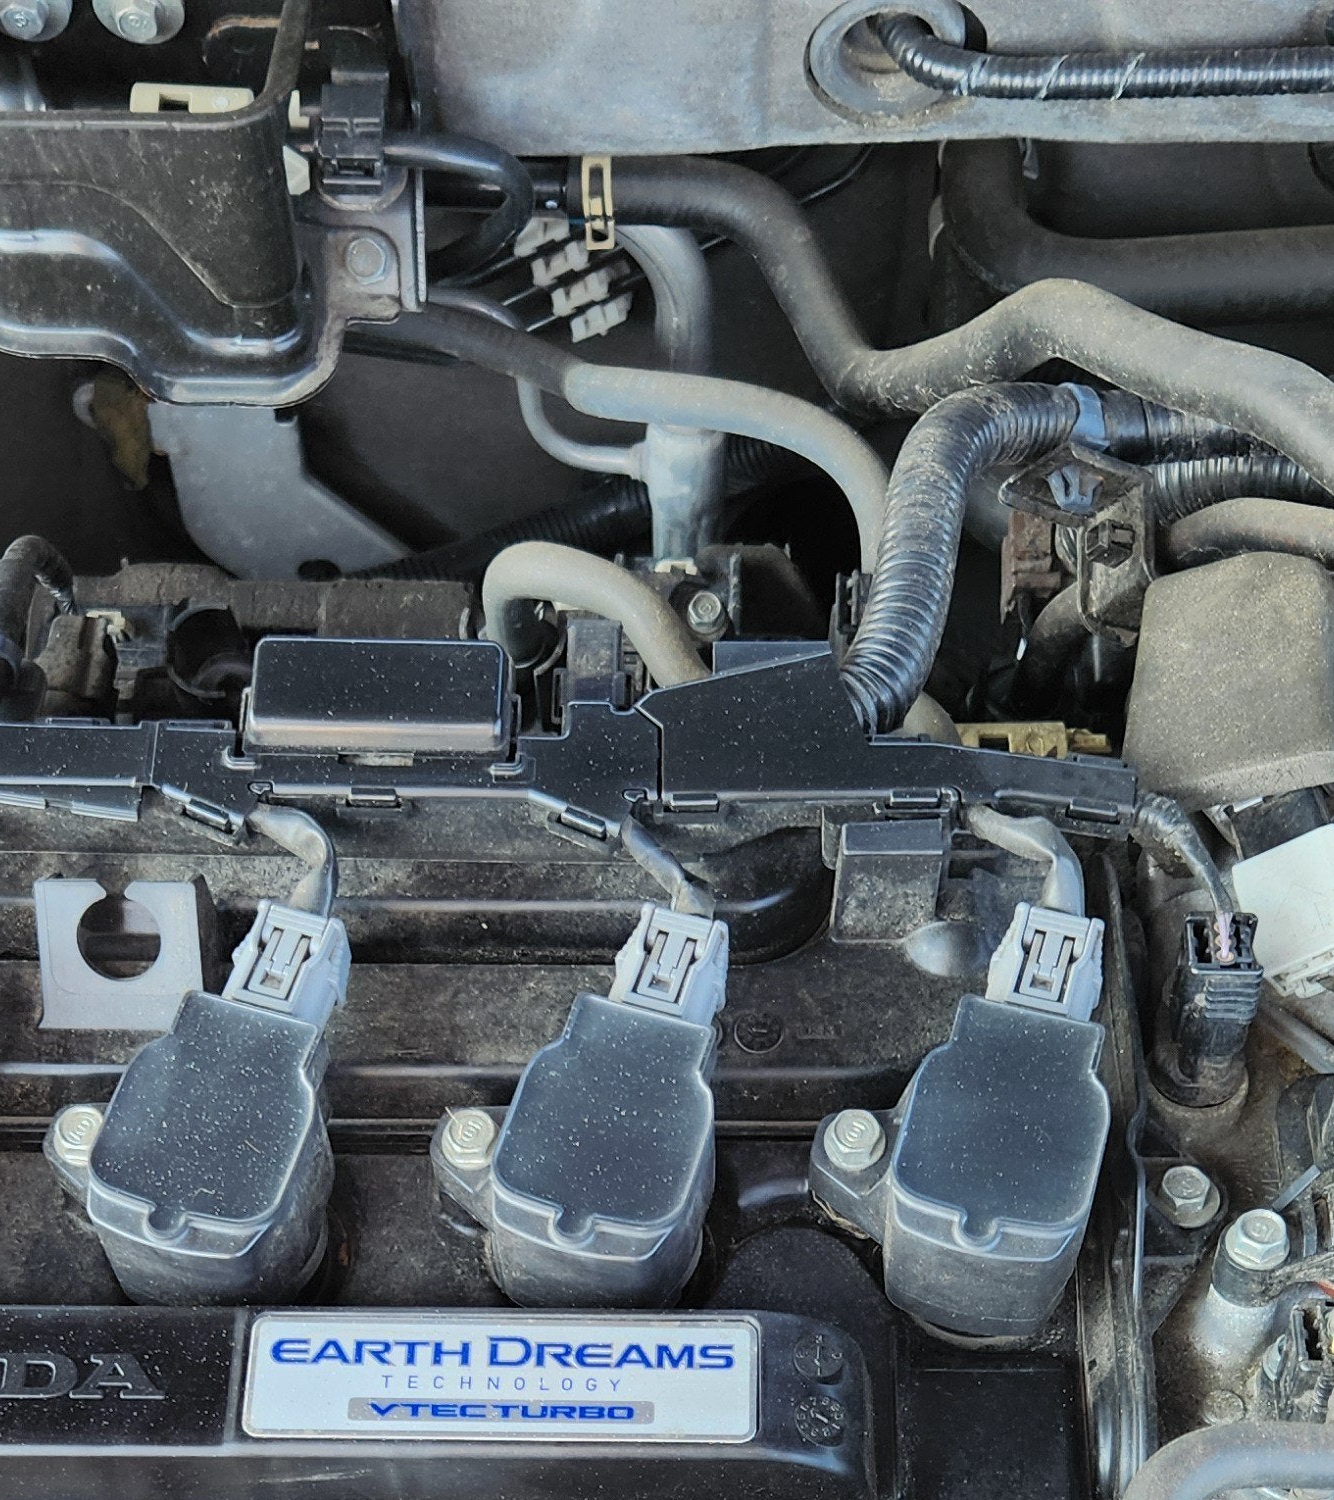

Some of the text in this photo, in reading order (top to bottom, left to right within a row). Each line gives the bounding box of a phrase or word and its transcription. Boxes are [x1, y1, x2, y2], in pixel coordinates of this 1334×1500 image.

[269, 1334, 737, 1371] EARTH DREAMS
[381, 1374, 623, 1393] TECHNOLOGY
